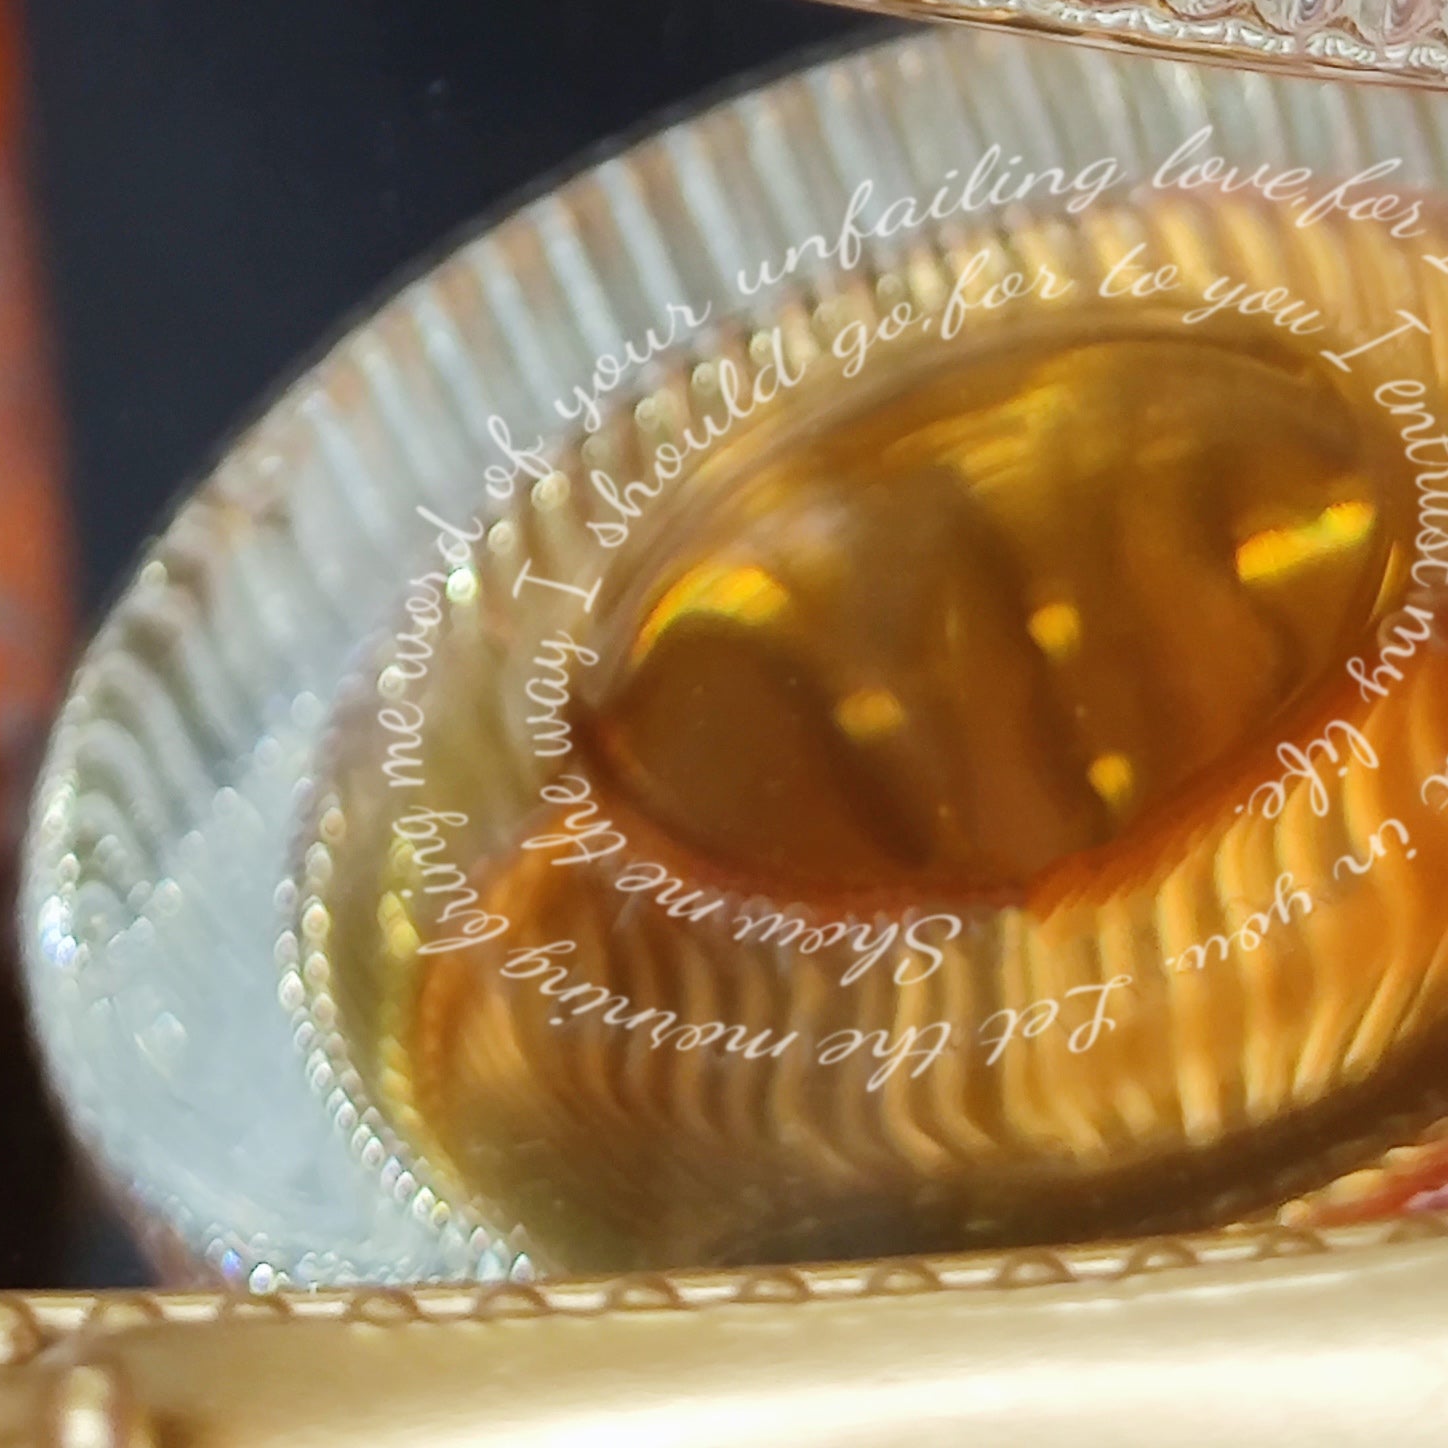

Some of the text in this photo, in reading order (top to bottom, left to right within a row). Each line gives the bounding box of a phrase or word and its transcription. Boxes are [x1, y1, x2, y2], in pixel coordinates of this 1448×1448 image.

[736, 142, 1129, 296] unfailing
[1098, 242, 1181, 299] to
[1181, 272, 1324, 335] you
[552, 299, 713, 432] your
[1320, 309, 1431, 373] I
[484, 414, 554, 502] of
[586, 328, 807, 549] should
[394, 505, 485, 682] word
[512, 558, 602, 613] I
[526, 630, 600, 756] way
[1346, 604, 1435, 703] my
[377, 700, 427, 788] me
[522, 774, 626, 866] the
[1332, 818, 1418, 881] in
[616, 861, 724, 922] me
[733, 913, 963, 988] Show
[500, 940, 799, 1061] morning
[977, 974, 1133, 1068] Let
[816, 1020, 953, 1094] the
